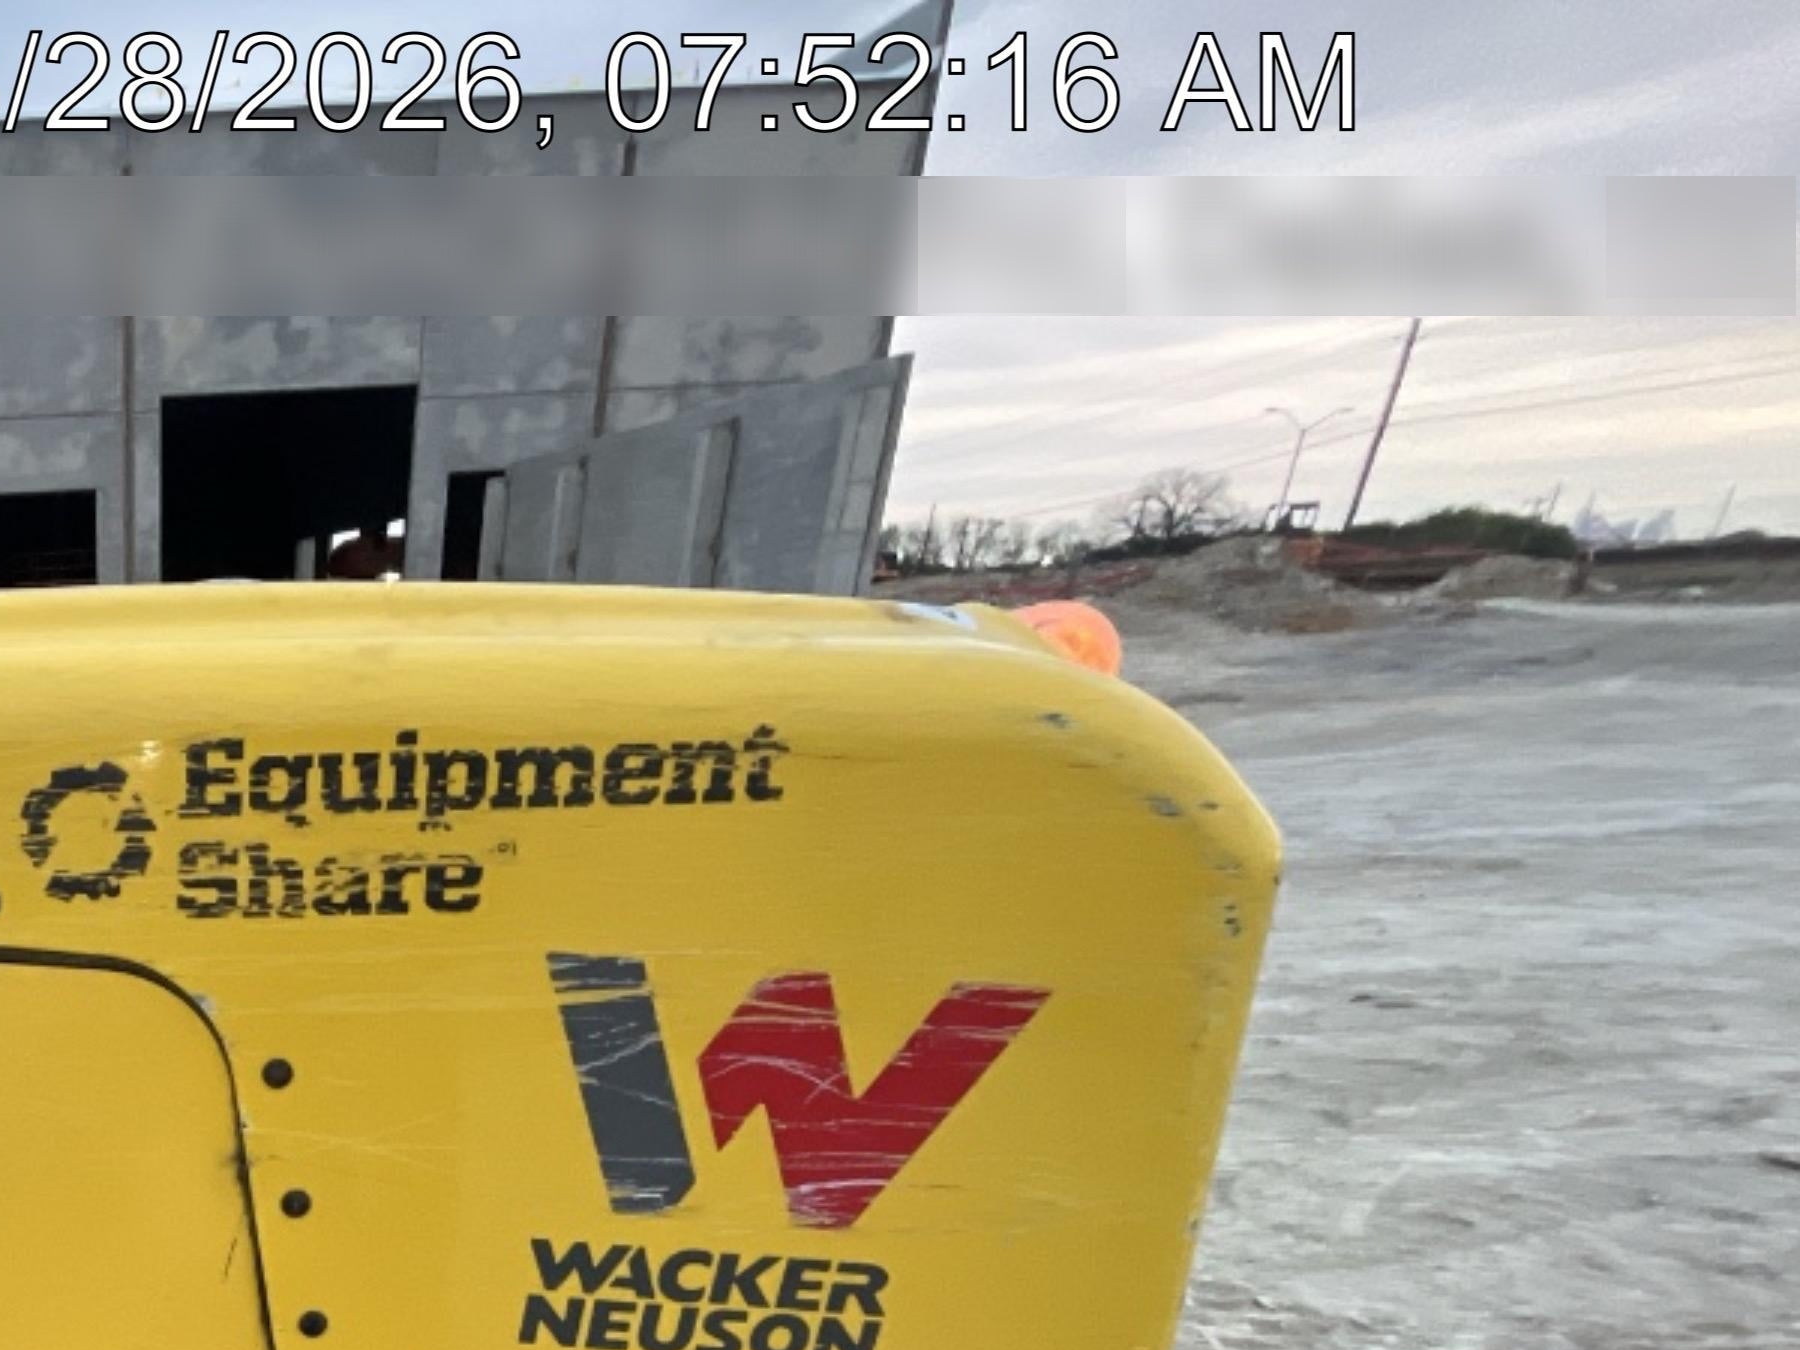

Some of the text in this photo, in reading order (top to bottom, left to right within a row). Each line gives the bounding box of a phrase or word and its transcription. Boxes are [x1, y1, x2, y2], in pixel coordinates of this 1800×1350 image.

[178, 724, 789, 833] Equipment
[176, 841, 484, 919] Share
[529, 1237, 890, 1317] WACKER
